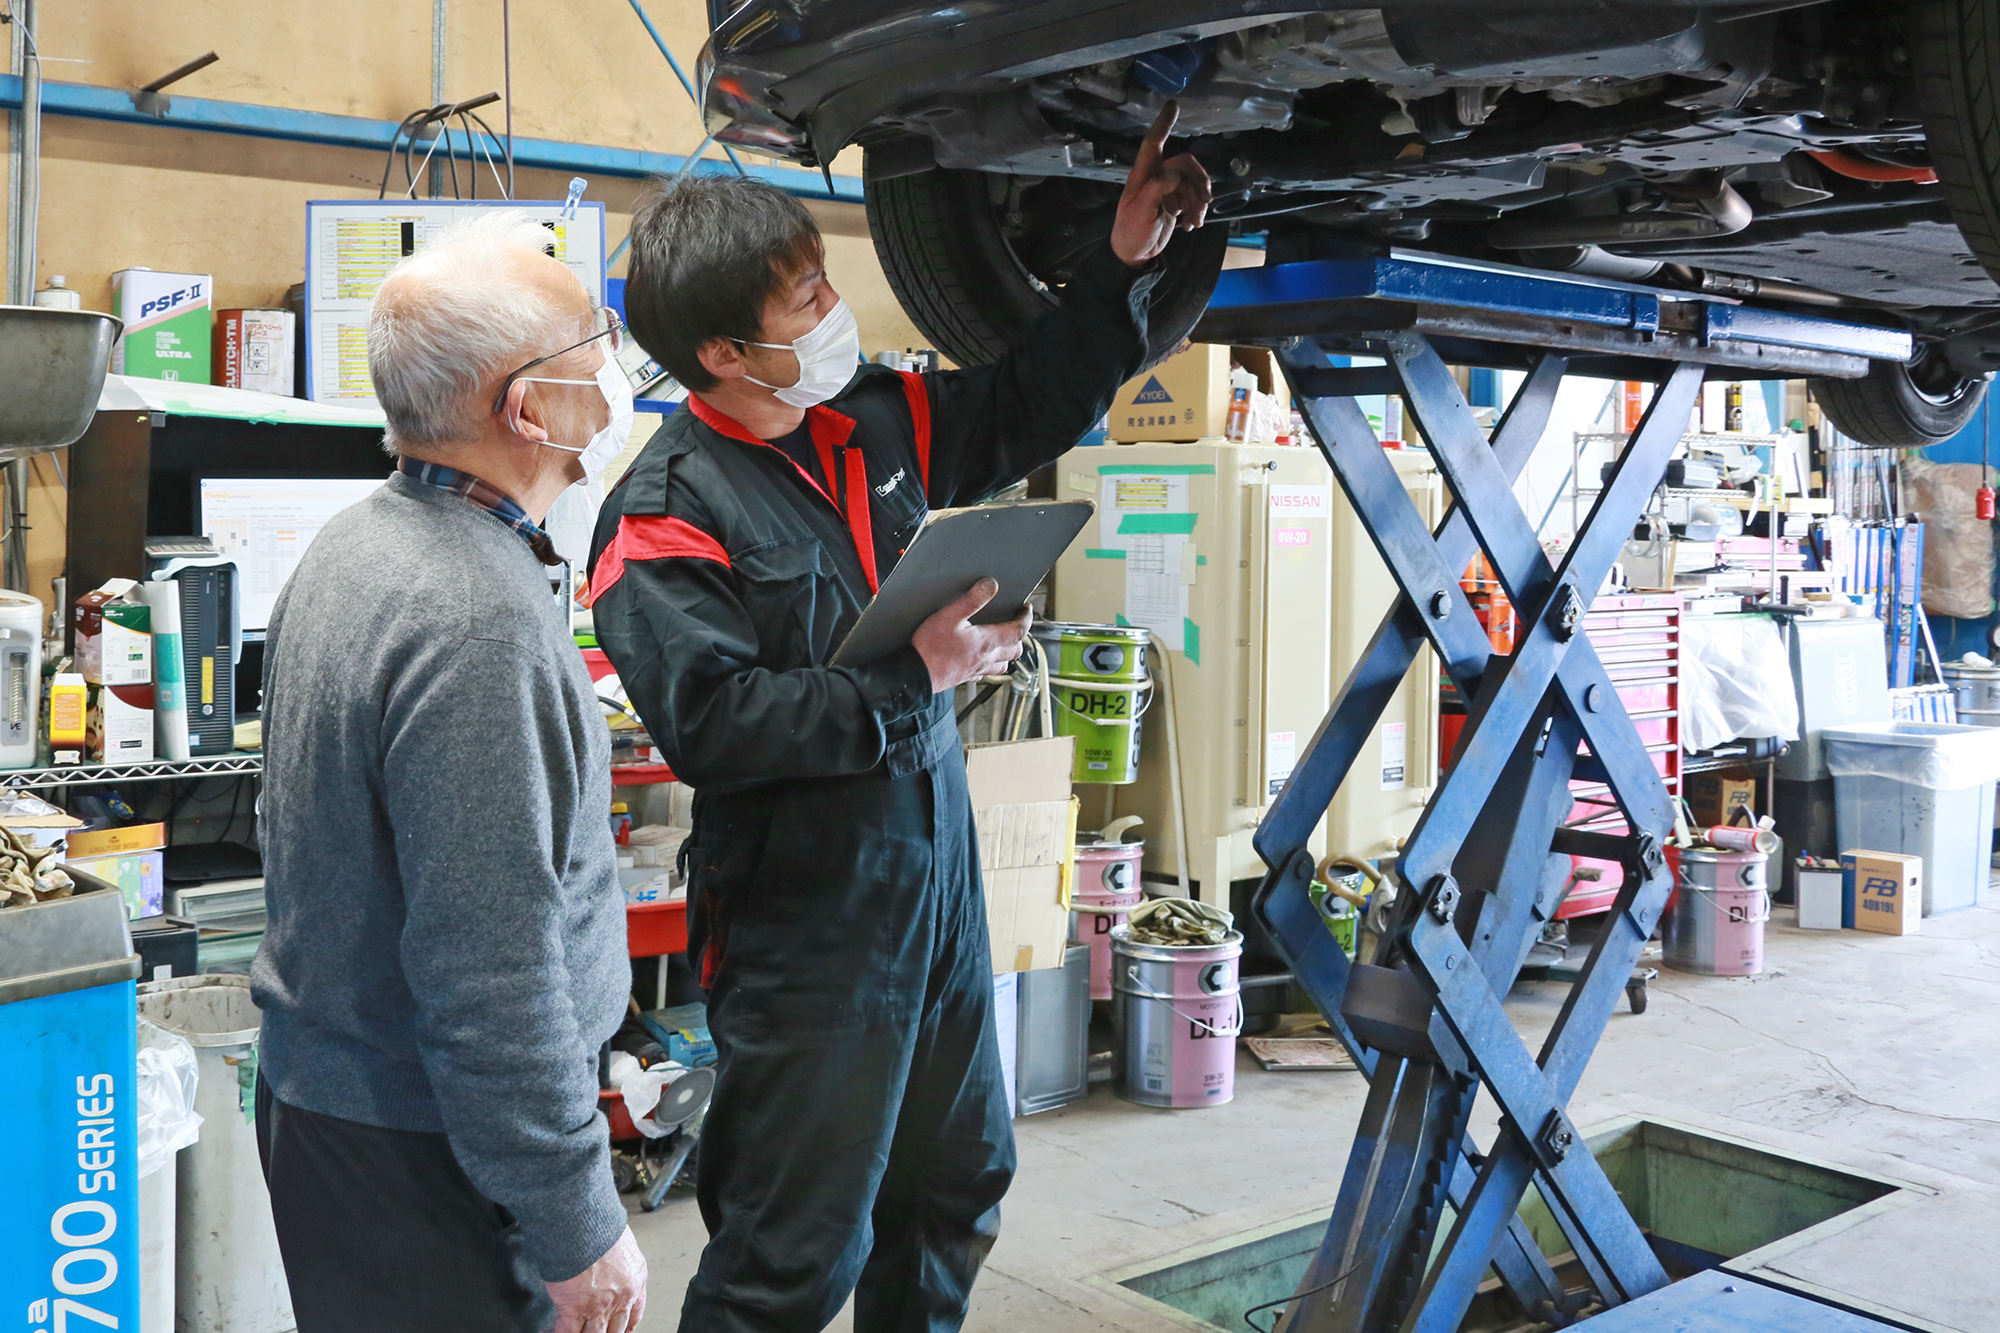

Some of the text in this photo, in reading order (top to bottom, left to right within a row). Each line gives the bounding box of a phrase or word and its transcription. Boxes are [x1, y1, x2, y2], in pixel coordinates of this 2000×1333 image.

[156, 350, 192, 359] ULTRA
[1139, 390, 1166, 400] KYOEI
[1270, 495, 1321, 507] NISSAN
[1278, 531, 1307, 543] 0W-20
[1070, 692, 1127, 716] DH-2
[1084, 748, 1113, 757] 10W-30
[1729, 791, 1750, 803] FB
[1862, 877, 1898, 897] FB
[76, 1073, 116, 1195] SERIES
